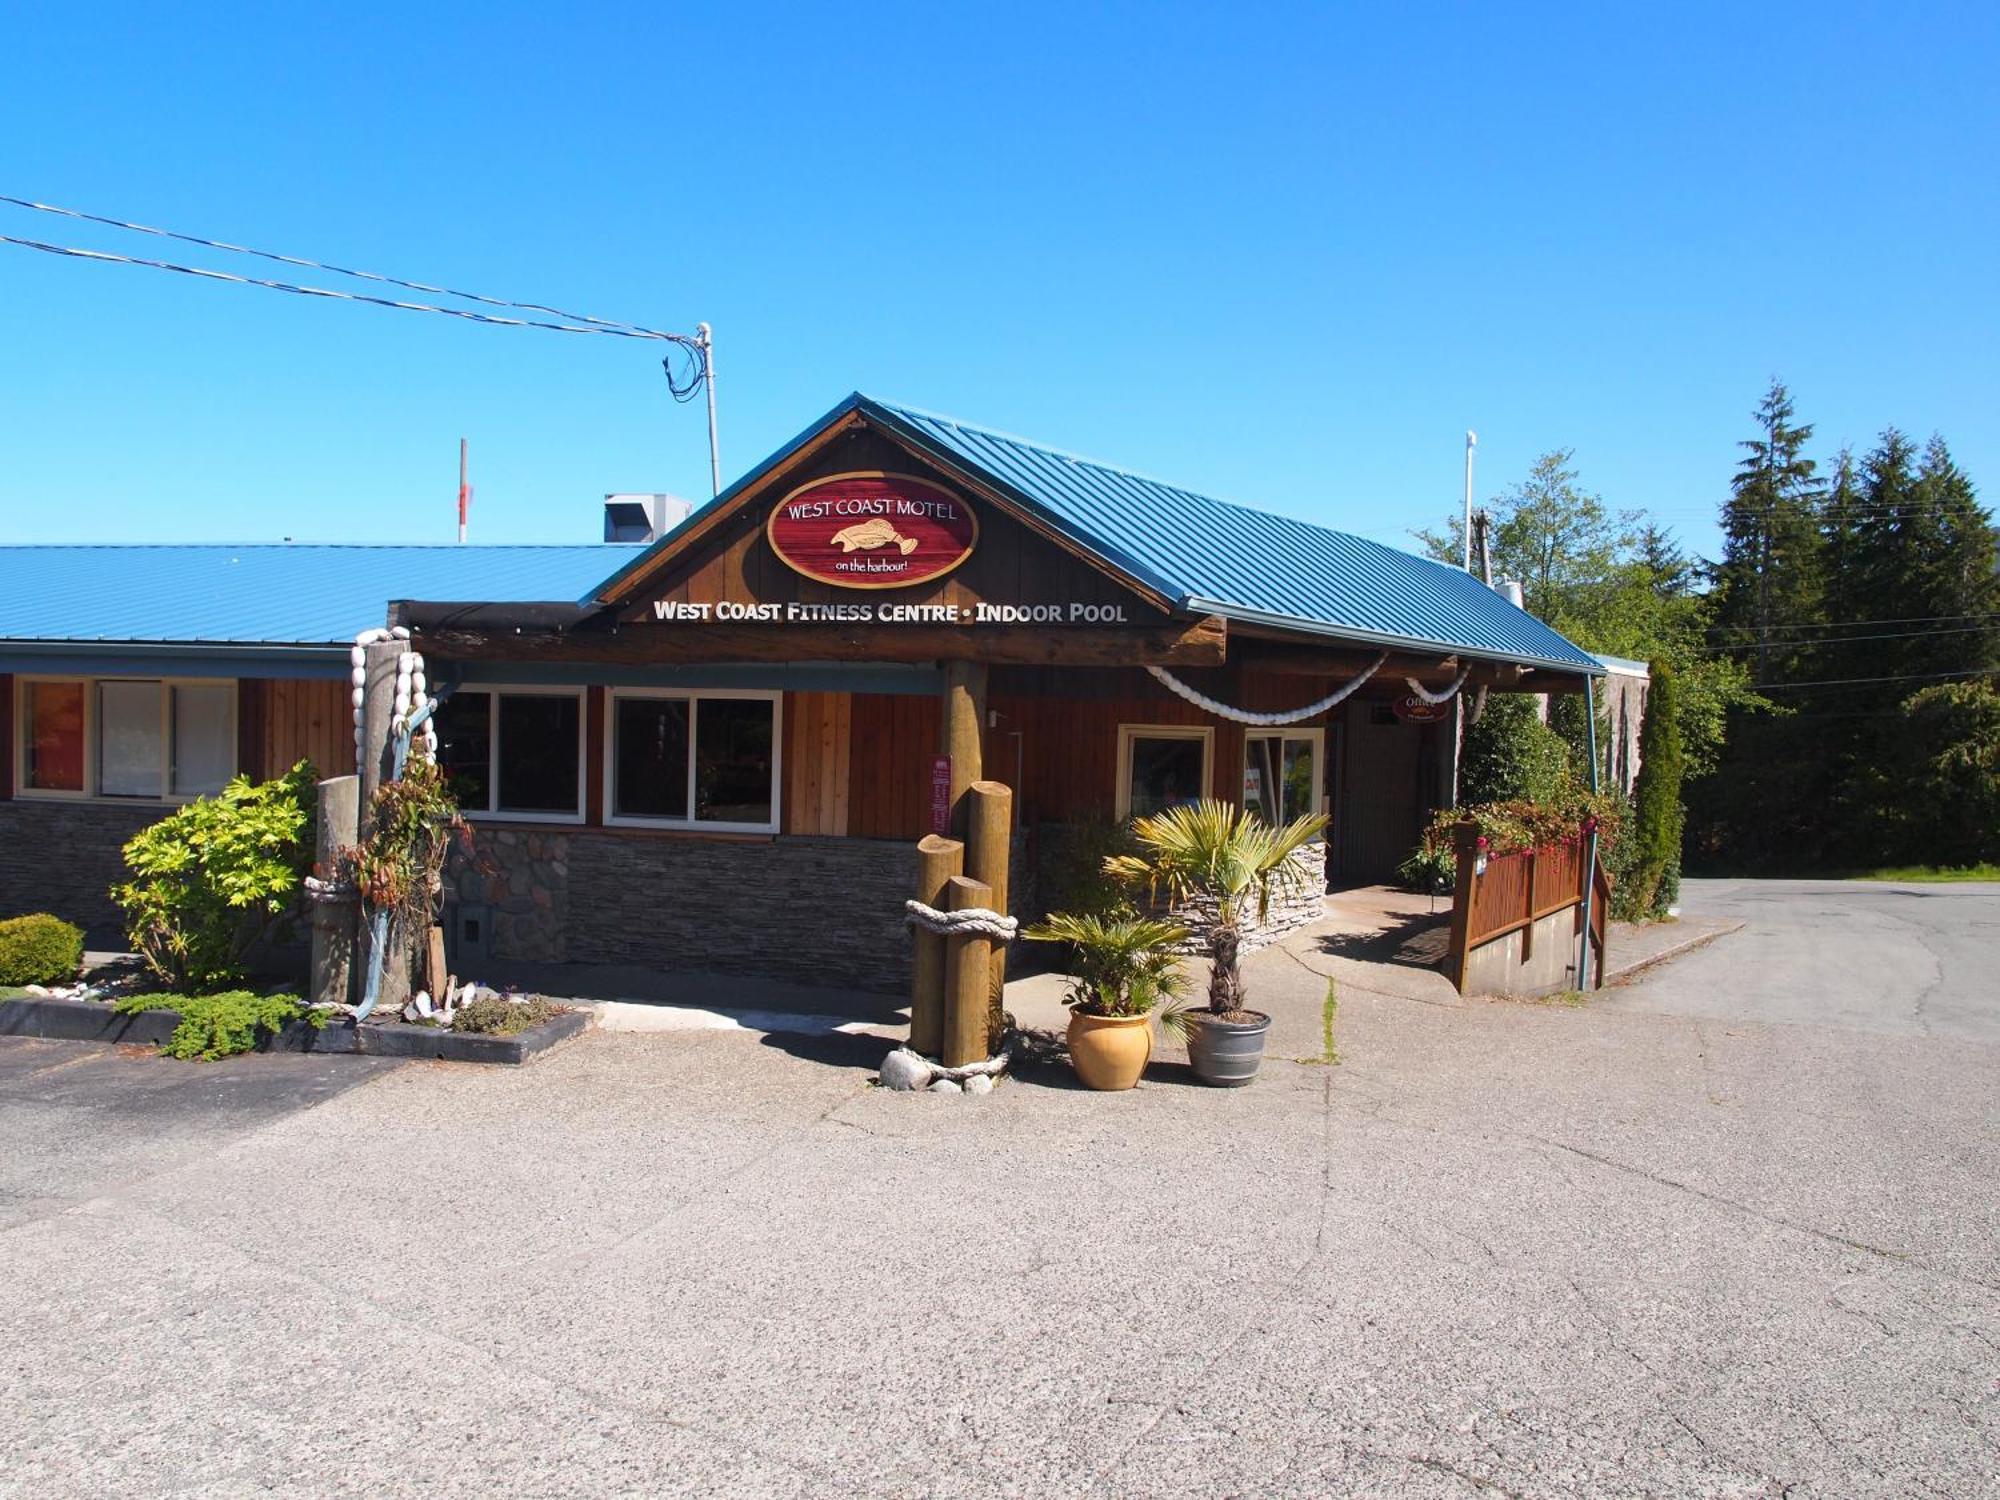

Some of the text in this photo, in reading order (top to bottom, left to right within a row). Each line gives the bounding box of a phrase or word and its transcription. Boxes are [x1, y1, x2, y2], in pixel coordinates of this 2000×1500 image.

[789, 499, 958, 519] WEST COAST MOTEL
[836, 558, 908, 572] on the harbour!
[654, 601, 1127, 622] WEST COAST FITNESS CENTRE INDOOR POOL
